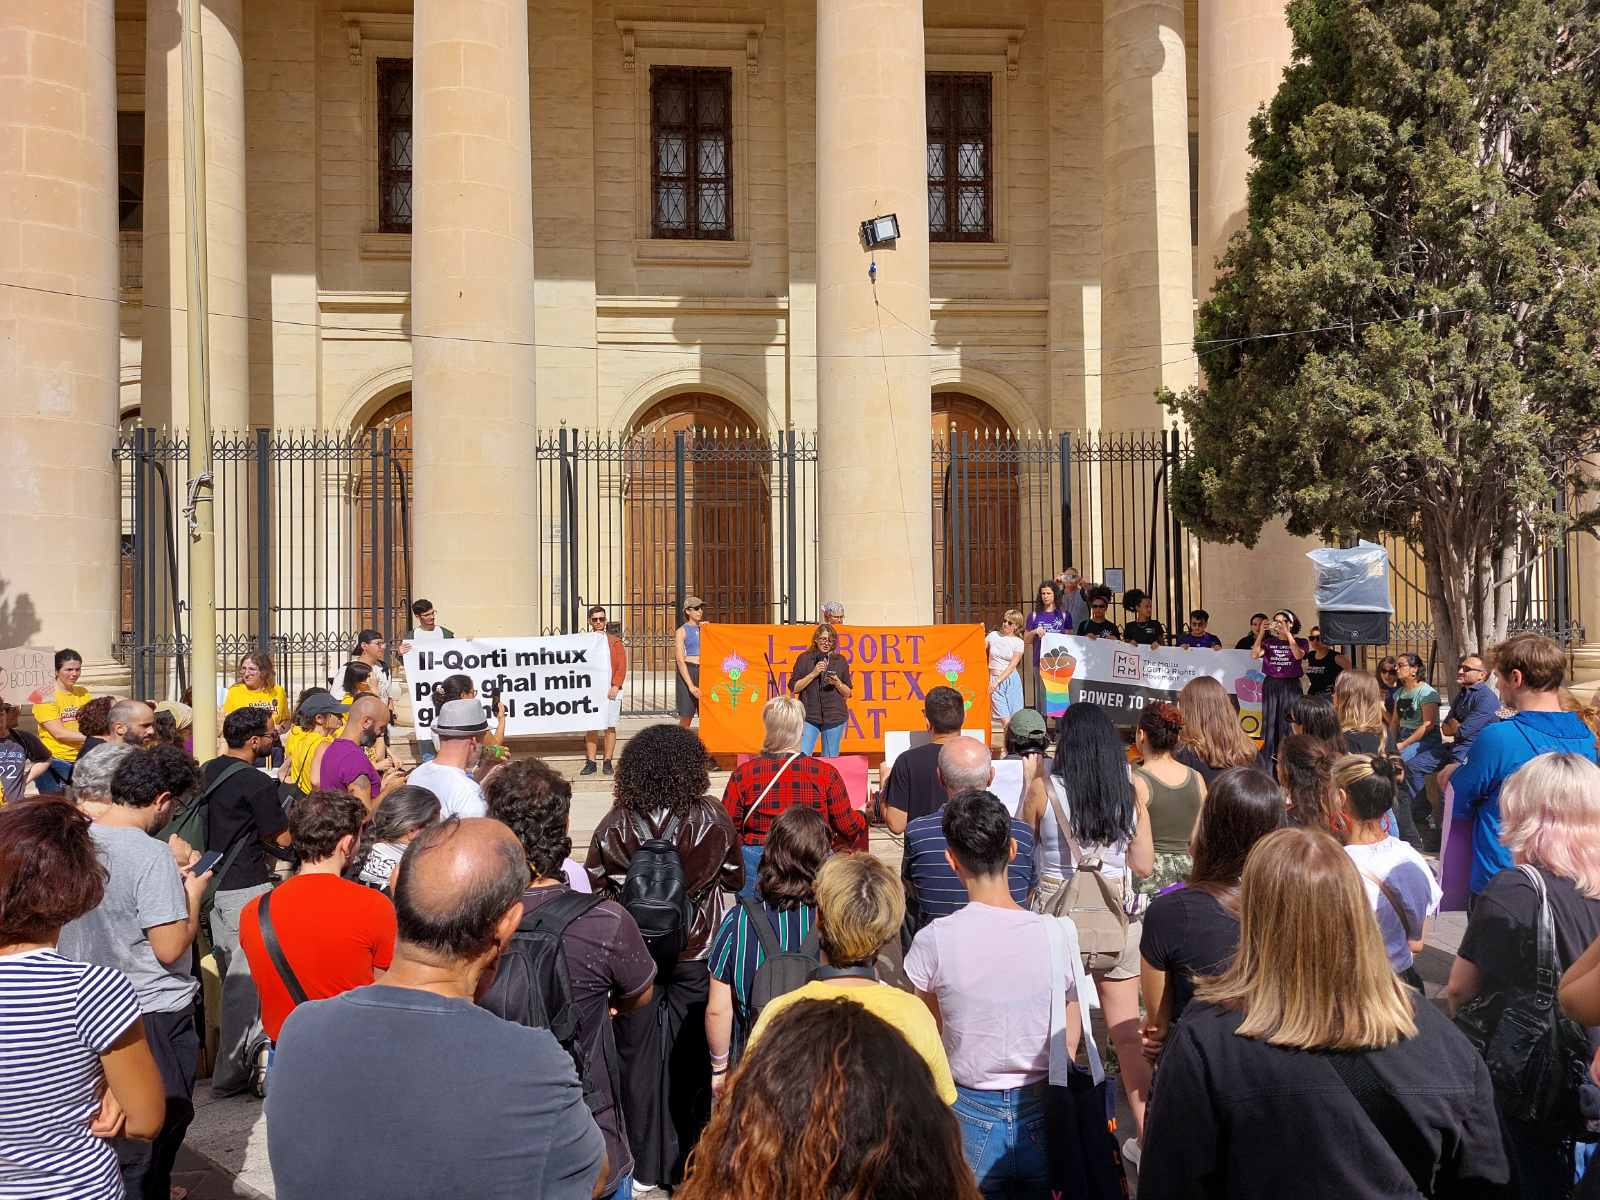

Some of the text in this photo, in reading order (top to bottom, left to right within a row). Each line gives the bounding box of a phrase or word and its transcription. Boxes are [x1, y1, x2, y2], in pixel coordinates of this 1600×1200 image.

[418, 647, 588, 670] Il-Qorti mhux
[768, 633, 925, 664] L-BORT
[544, 671, 591, 690] min
[523, 695, 599, 717] abort.
[1079, 689, 1123, 708] POWER
[1128, 695, 1143, 710] TO
